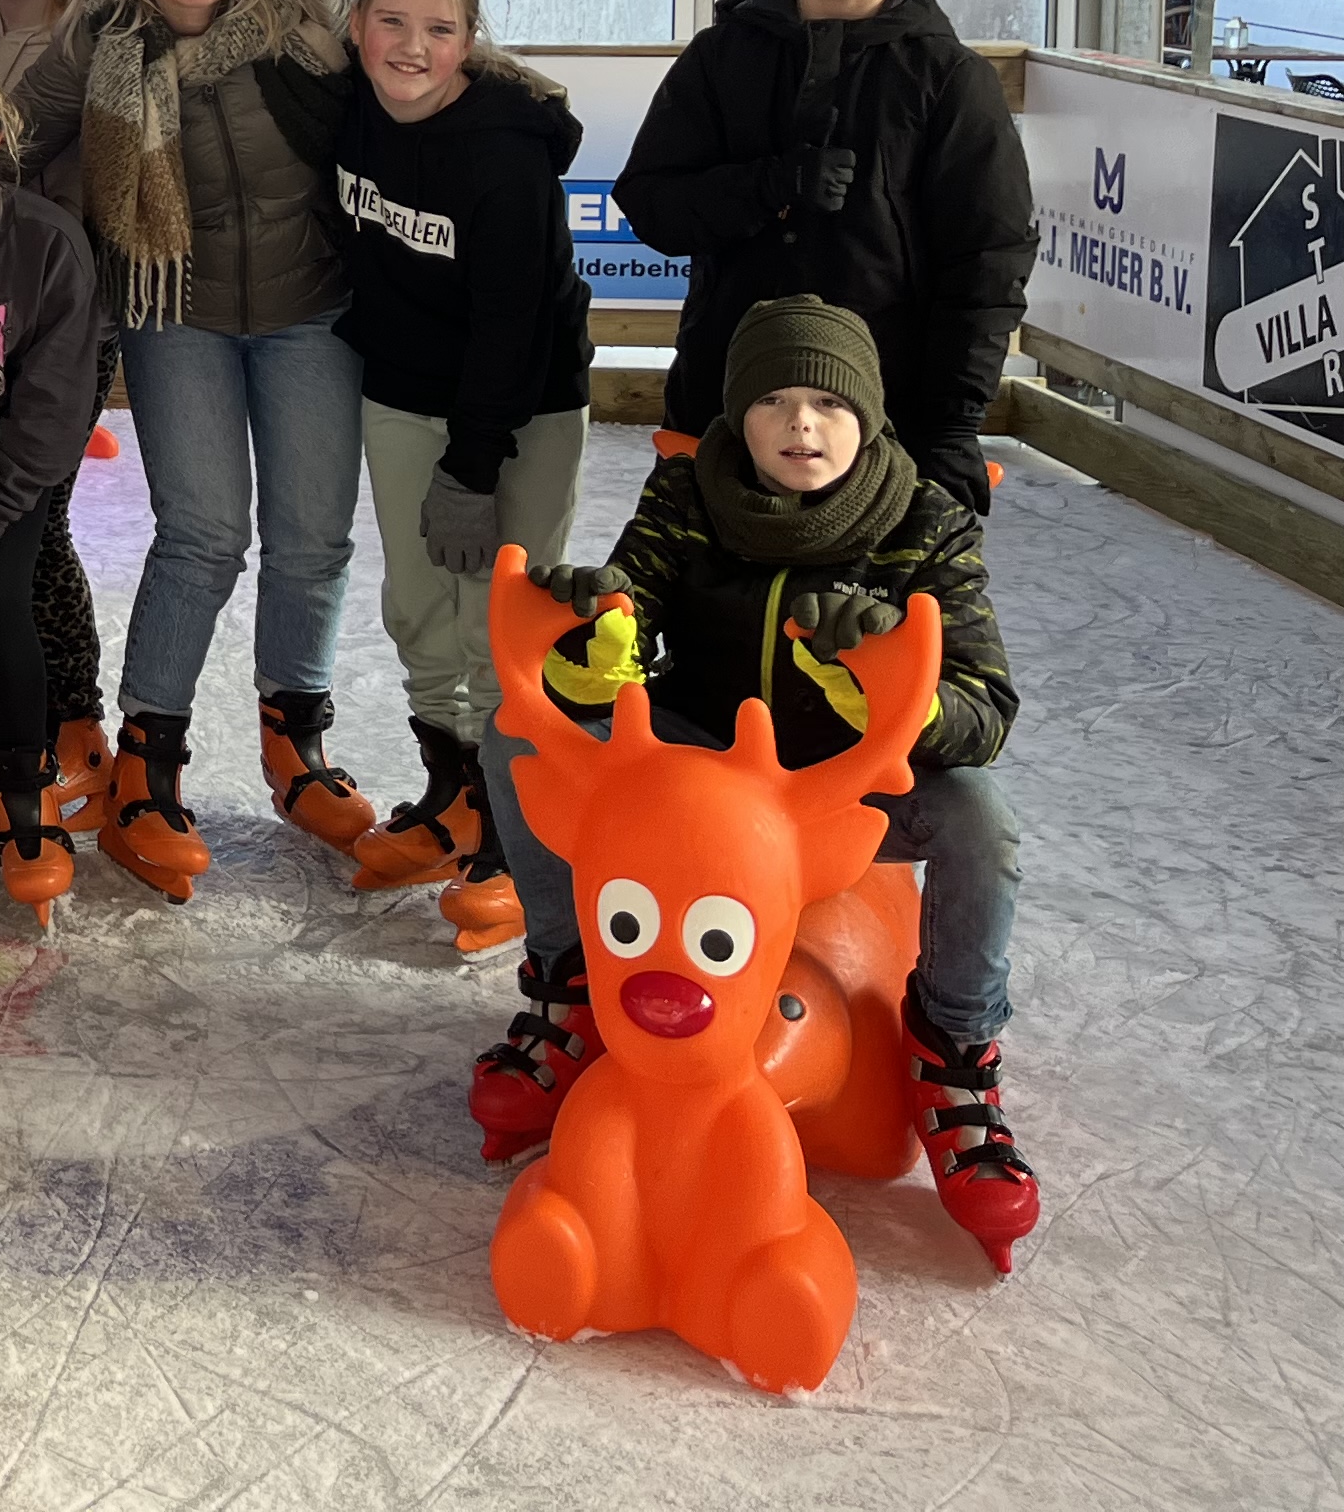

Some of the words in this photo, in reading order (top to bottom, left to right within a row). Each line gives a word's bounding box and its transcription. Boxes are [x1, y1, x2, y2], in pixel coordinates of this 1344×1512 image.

[572, 257, 691, 278] lderbehe
[1038, 205, 1196, 266] ANNEMINGSBEDRIJF
[1070, 231, 1143, 297] MEIJER
[1150, 258, 1192, 315] B.V.
[1256, 294, 1337, 363] VILLA
